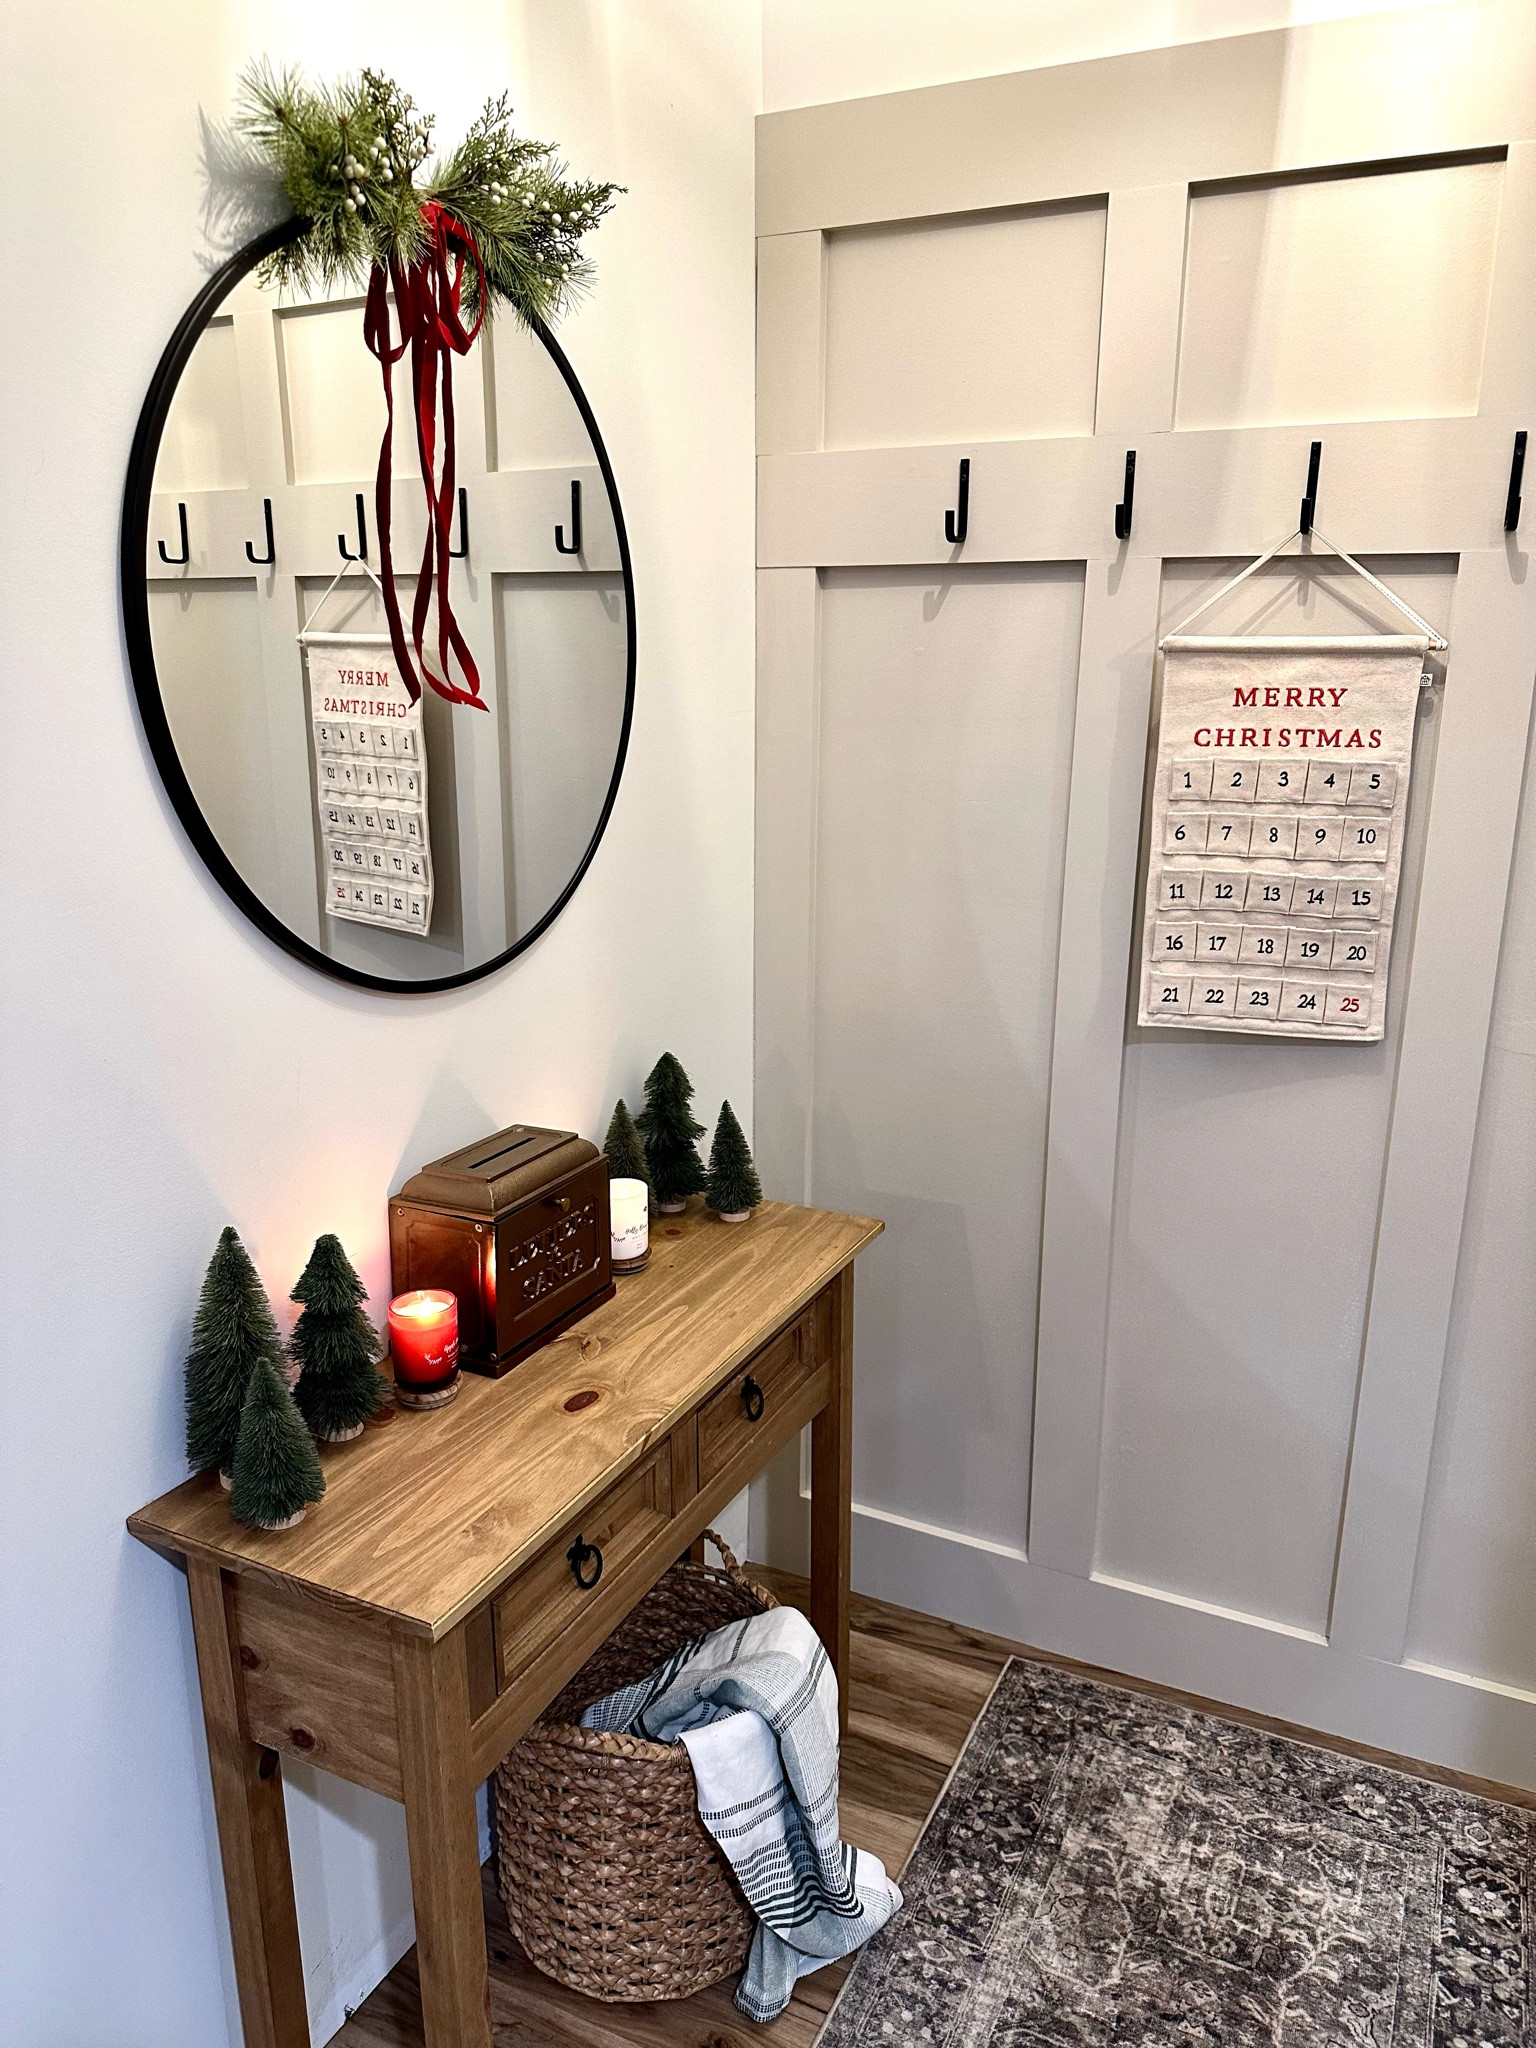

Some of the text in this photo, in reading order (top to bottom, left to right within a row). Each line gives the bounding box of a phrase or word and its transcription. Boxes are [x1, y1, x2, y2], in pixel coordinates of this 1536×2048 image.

[1233, 688, 1348, 707] MERRY
[1194, 728, 1381, 748] CHRISTMAS
[1184, 771, 1380, 789] 1 2 3 4 5
[1175, 825, 1376, 845] 6 7 8 9 10
[1169, 884, 1370, 905] 11 12 13 14 15
[1166, 935, 1366, 960] 16 17 18 19 20
[1162, 987, 1359, 1012] 21 22 23 24 25
[523, 1248, 583, 1298] SANTA
